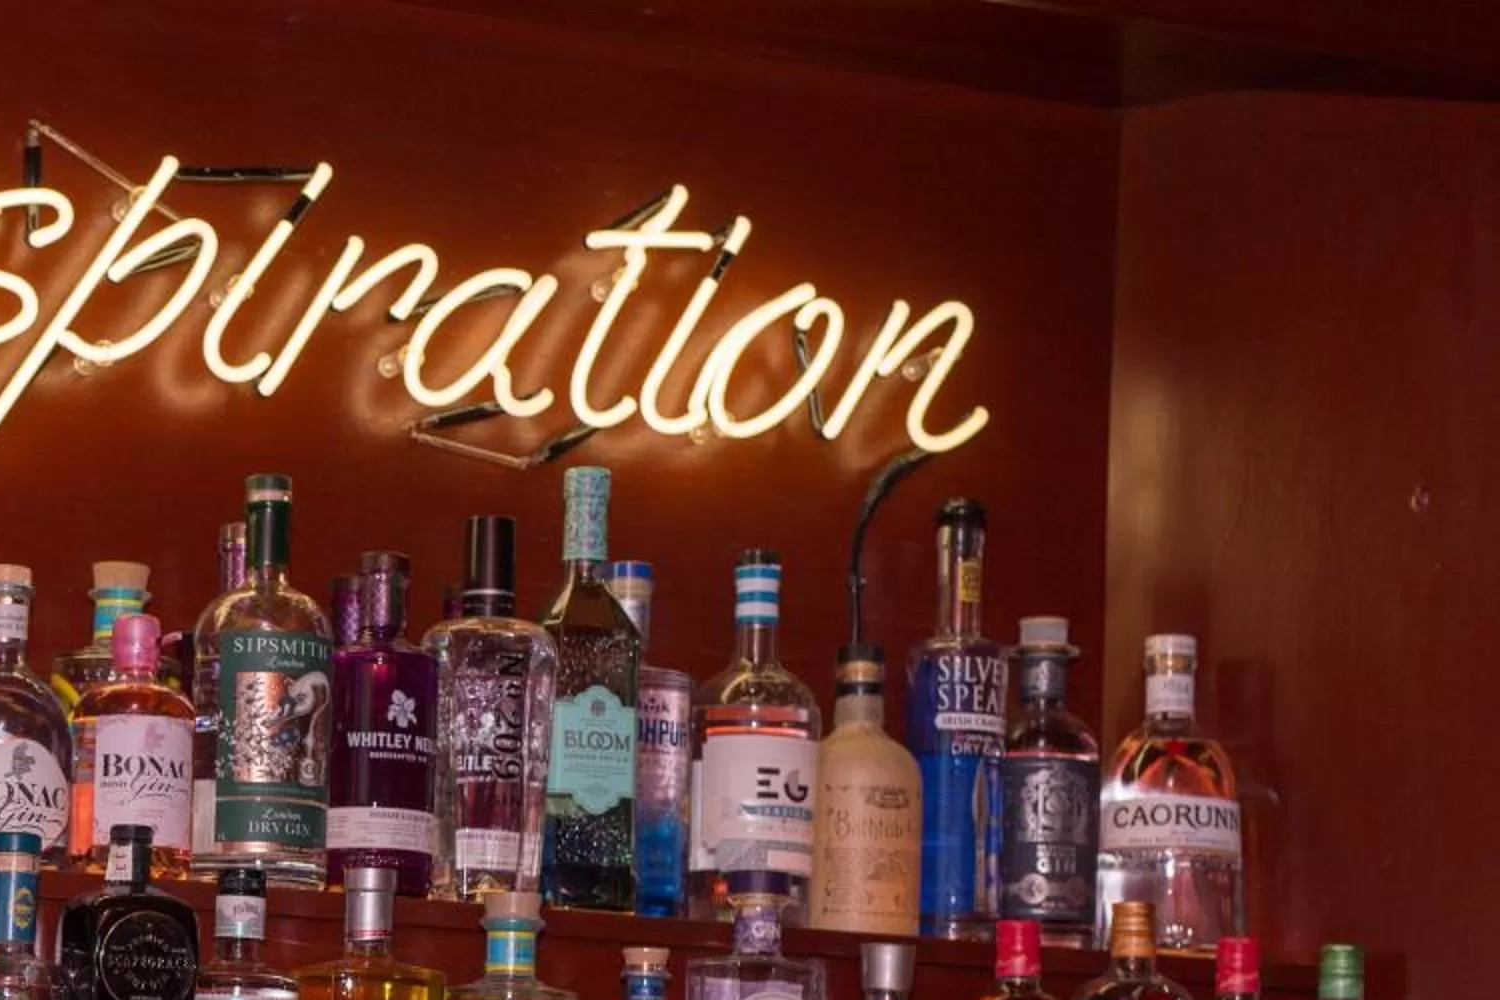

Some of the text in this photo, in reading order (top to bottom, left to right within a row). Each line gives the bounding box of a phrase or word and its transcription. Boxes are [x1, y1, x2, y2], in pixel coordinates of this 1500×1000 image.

[232, 636, 328, 659] SIPSMITH
[936, 685, 1001, 715] SPEA
[347, 731, 412, 750] WHITLEY
[564, 728, 632, 753] BLOOM
[101, 752, 191, 780] BONAC
[756, 766, 809, 800] EG
[248, 820, 282, 835] DRY
[1113, 802, 1240, 833] CAORUNN
